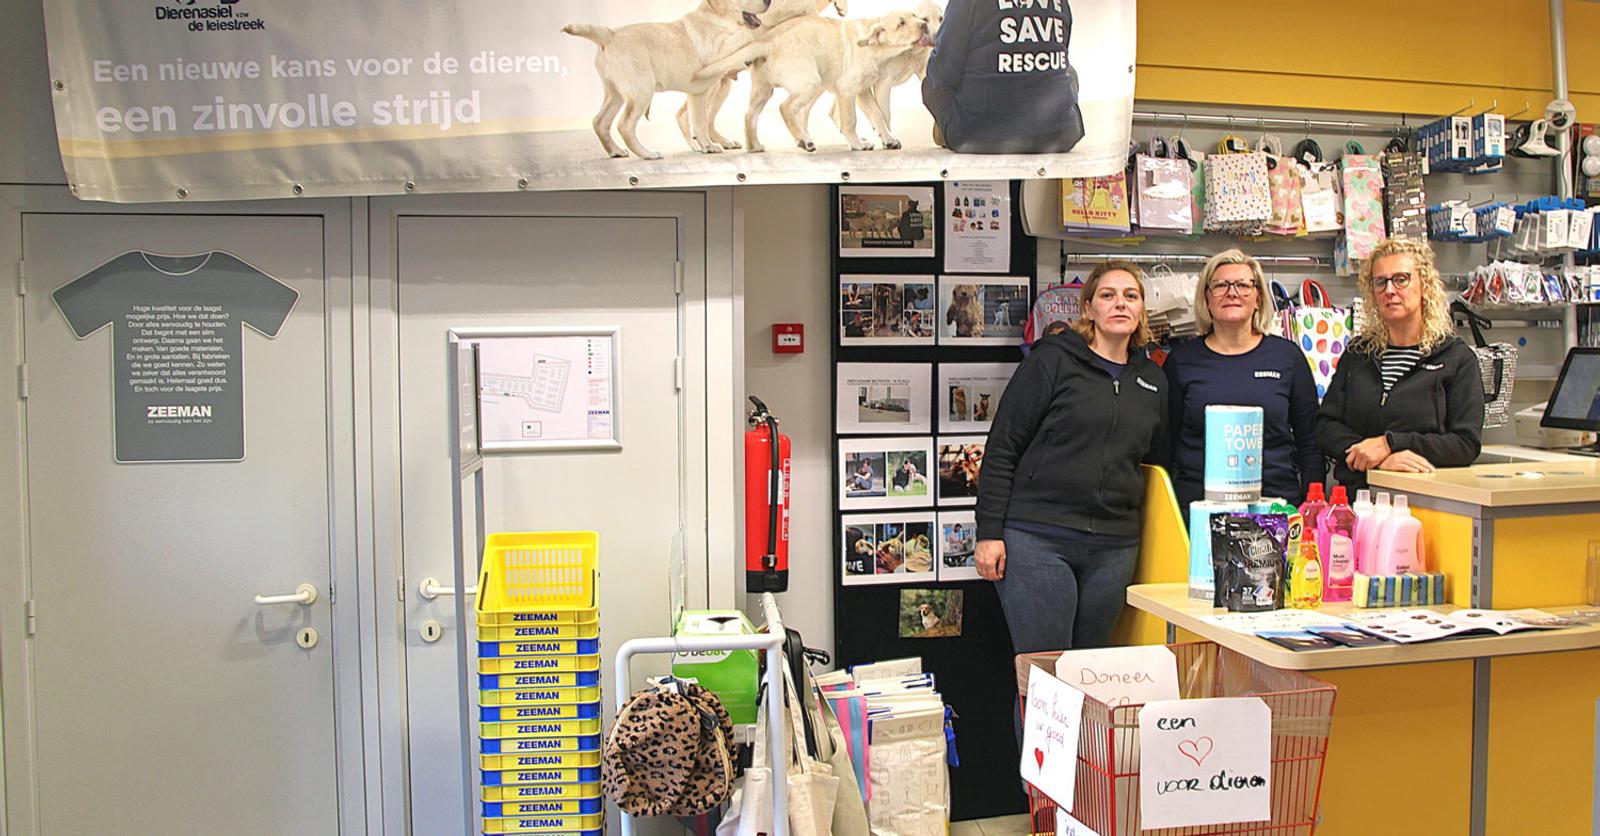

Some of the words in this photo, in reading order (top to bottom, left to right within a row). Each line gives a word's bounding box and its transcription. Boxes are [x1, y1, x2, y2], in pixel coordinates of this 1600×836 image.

[156, 5, 232, 20] Dierenasiel
[188, 20, 204, 31] de
[1000, 16, 1064, 44] SAVE
[93, 60, 148, 82] Een
[159, 57, 260, 81] nieuwe
[270, 54, 336, 78] kans
[342, 54, 414, 76] voor
[422, 52, 459, 76] de
[470, 50, 569, 78] dieren,
[998, 52, 1066, 72] RESCUE
[96, 100, 178, 134] een
[192, 92, 357, 132] zinvolle
[372, 90, 482, 130] strijd
[1254, 371, 1281, 379] ZEEMAN
[147, 405, 212, 417] ZEEMAN
[516, 644, 560, 652] ZEEMAN
[515, 660, 558, 668] ZEEMAN
[515, 676, 559, 684] ZEEMAN
[517, 708, 560, 716] ZEEMAN
[1157, 717, 1196, 730] een
[518, 724, 561, 733] ZEEMAN
[518, 741, 560, 749] ZEEMAN
[518, 757, 562, 765] ZEEMAN
[519, 787, 562, 795] ZEEMAN
[519, 804, 562, 812] ZEEMAN
